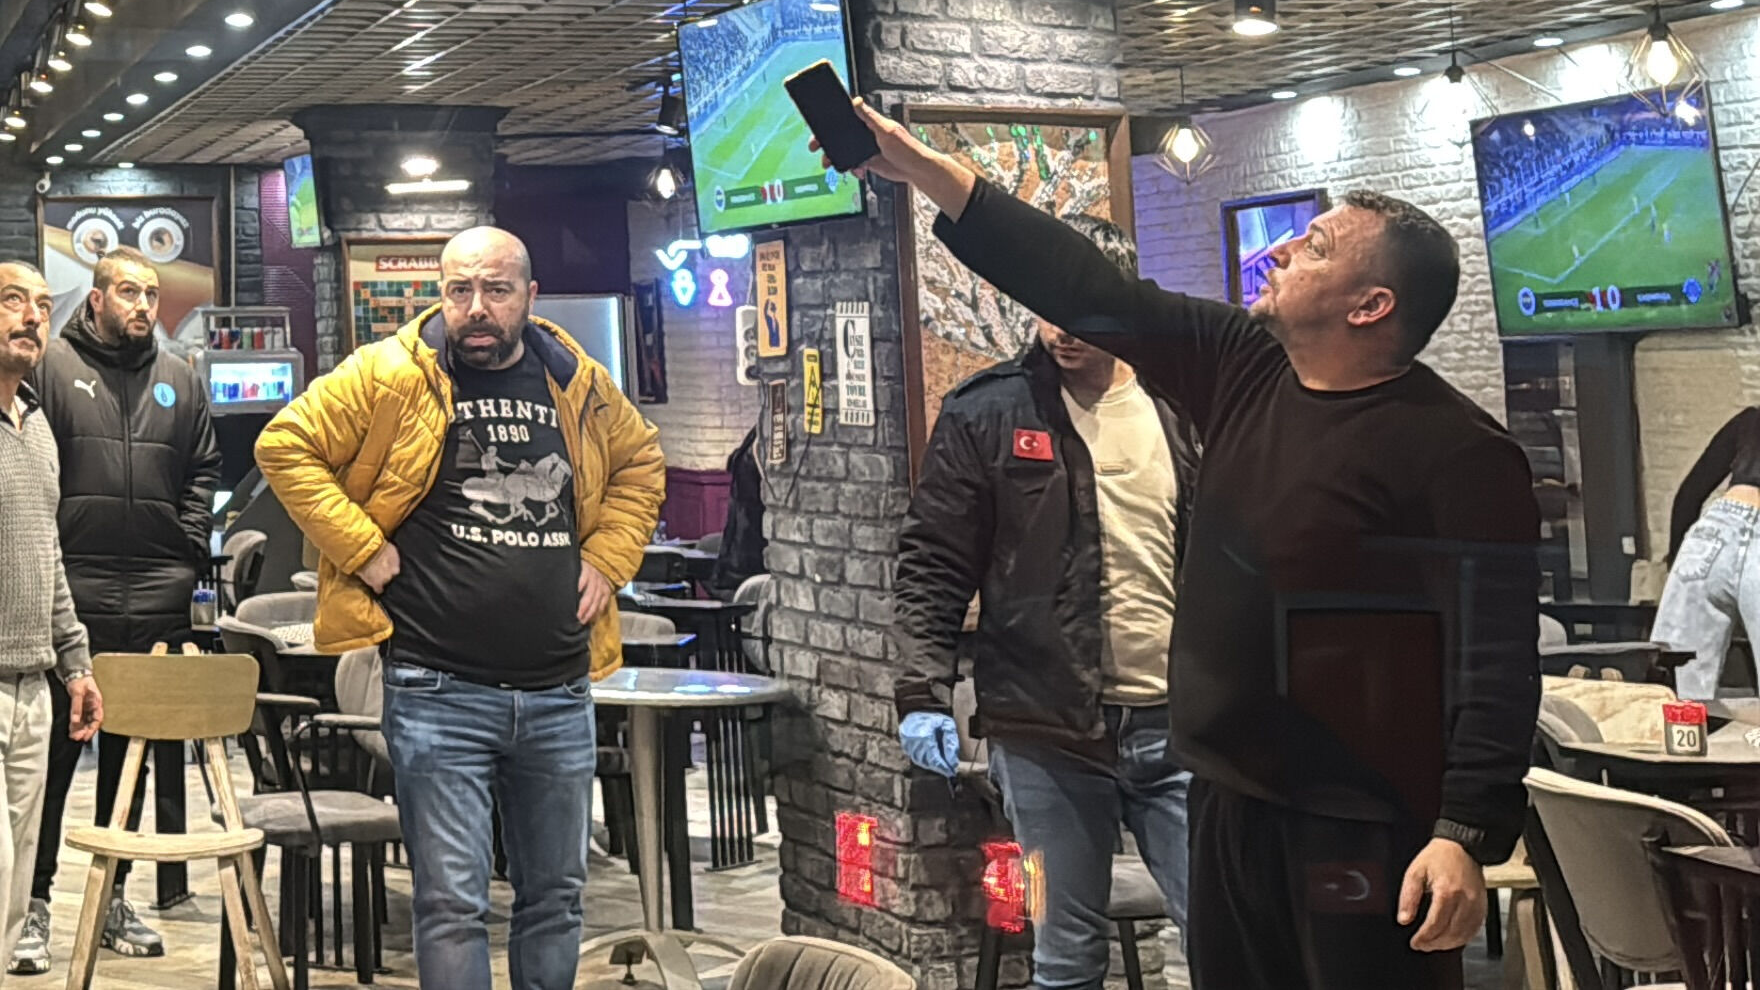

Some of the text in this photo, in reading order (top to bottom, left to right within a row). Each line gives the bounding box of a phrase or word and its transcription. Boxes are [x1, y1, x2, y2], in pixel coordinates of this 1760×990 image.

[378, 256, 440, 270] SCRABB
[449, 398, 559, 428] THENTI
[486, 423, 530, 443] 1890
[451, 523, 488, 544] U.S.
[491, 528, 540, 547] POLO
[1676, 729, 1697, 748] 20
